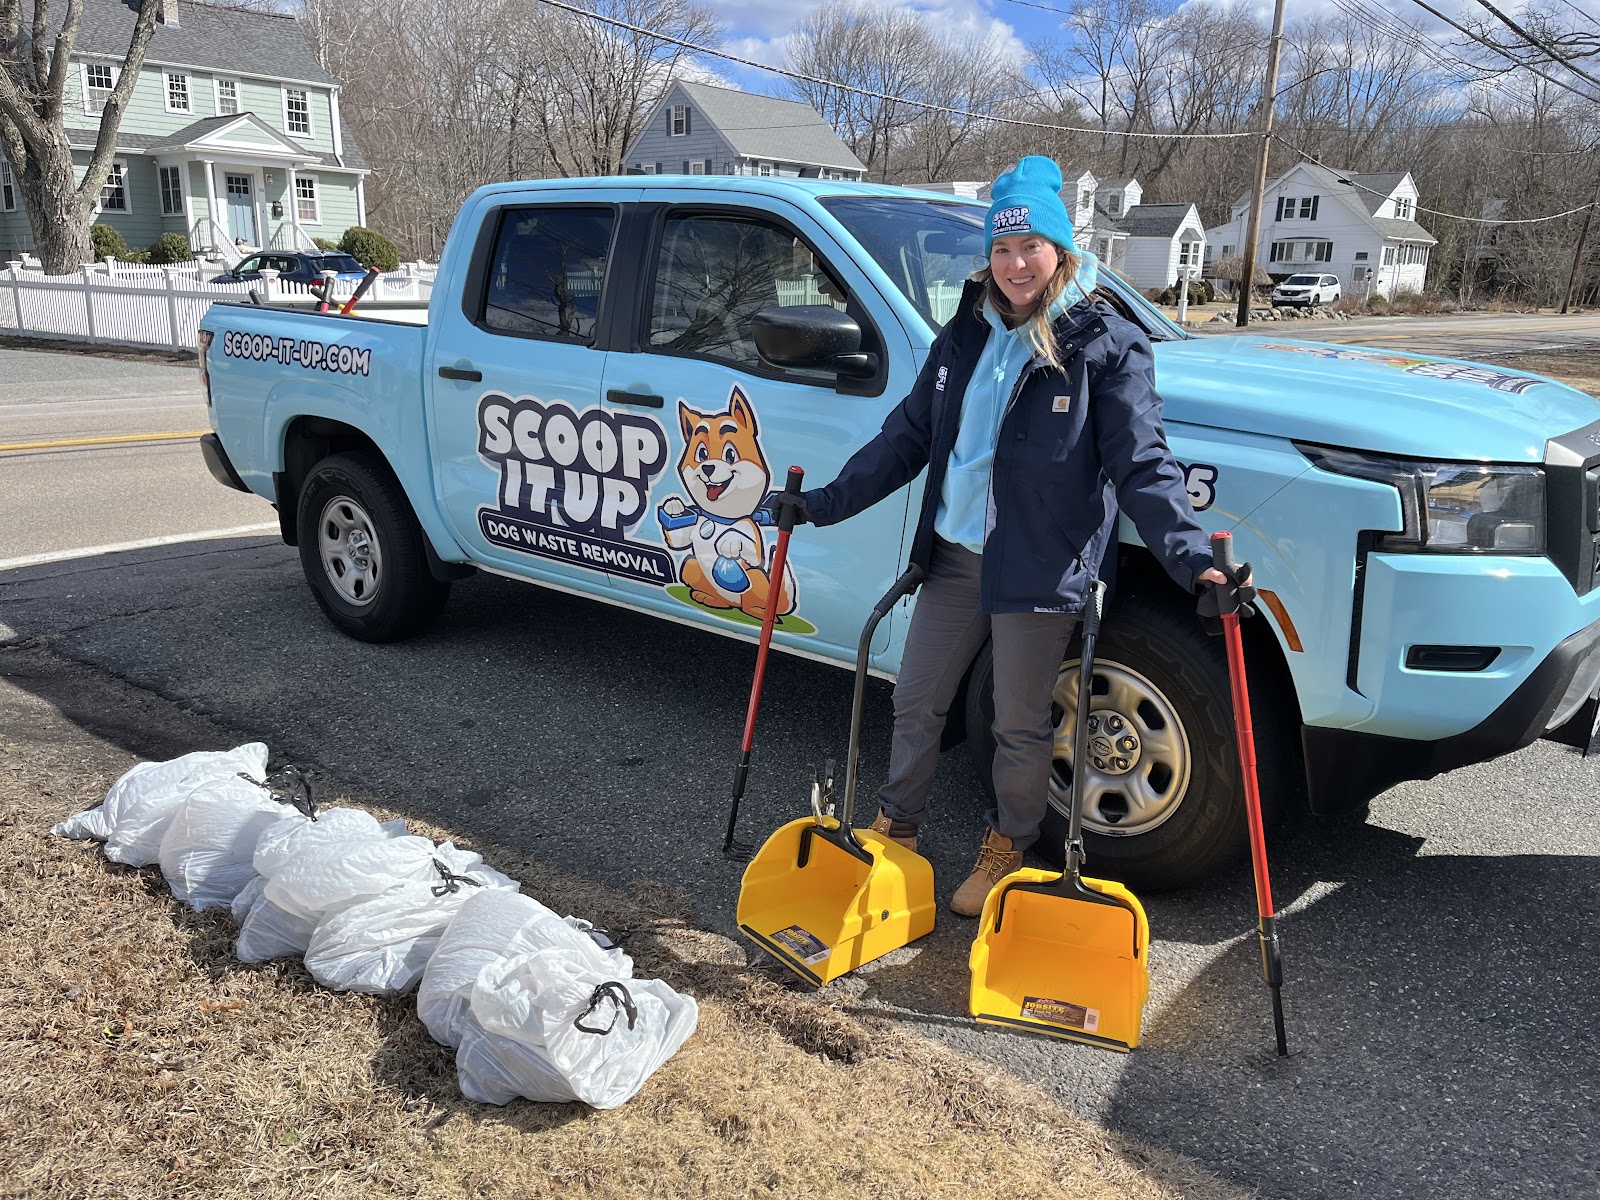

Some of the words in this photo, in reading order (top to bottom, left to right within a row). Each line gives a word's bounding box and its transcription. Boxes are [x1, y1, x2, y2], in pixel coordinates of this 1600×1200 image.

[994, 207, 1029, 221] SCOOP
[997, 218, 1008, 228] IT
[1008, 215, 1024, 225] UP
[224, 331, 371, 377] SCOOP-IT-UP.COM
[483, 404, 660, 479] SCOOP
[505, 459, 555, 513] IT
[563, 470, 640, 530] UP
[486, 519, 520, 543] DOG
[523, 527, 579, 557] WASTE
[581, 542, 665, 578] REMOVAL
[1024, 1001, 1065, 1014] JOBSITE
